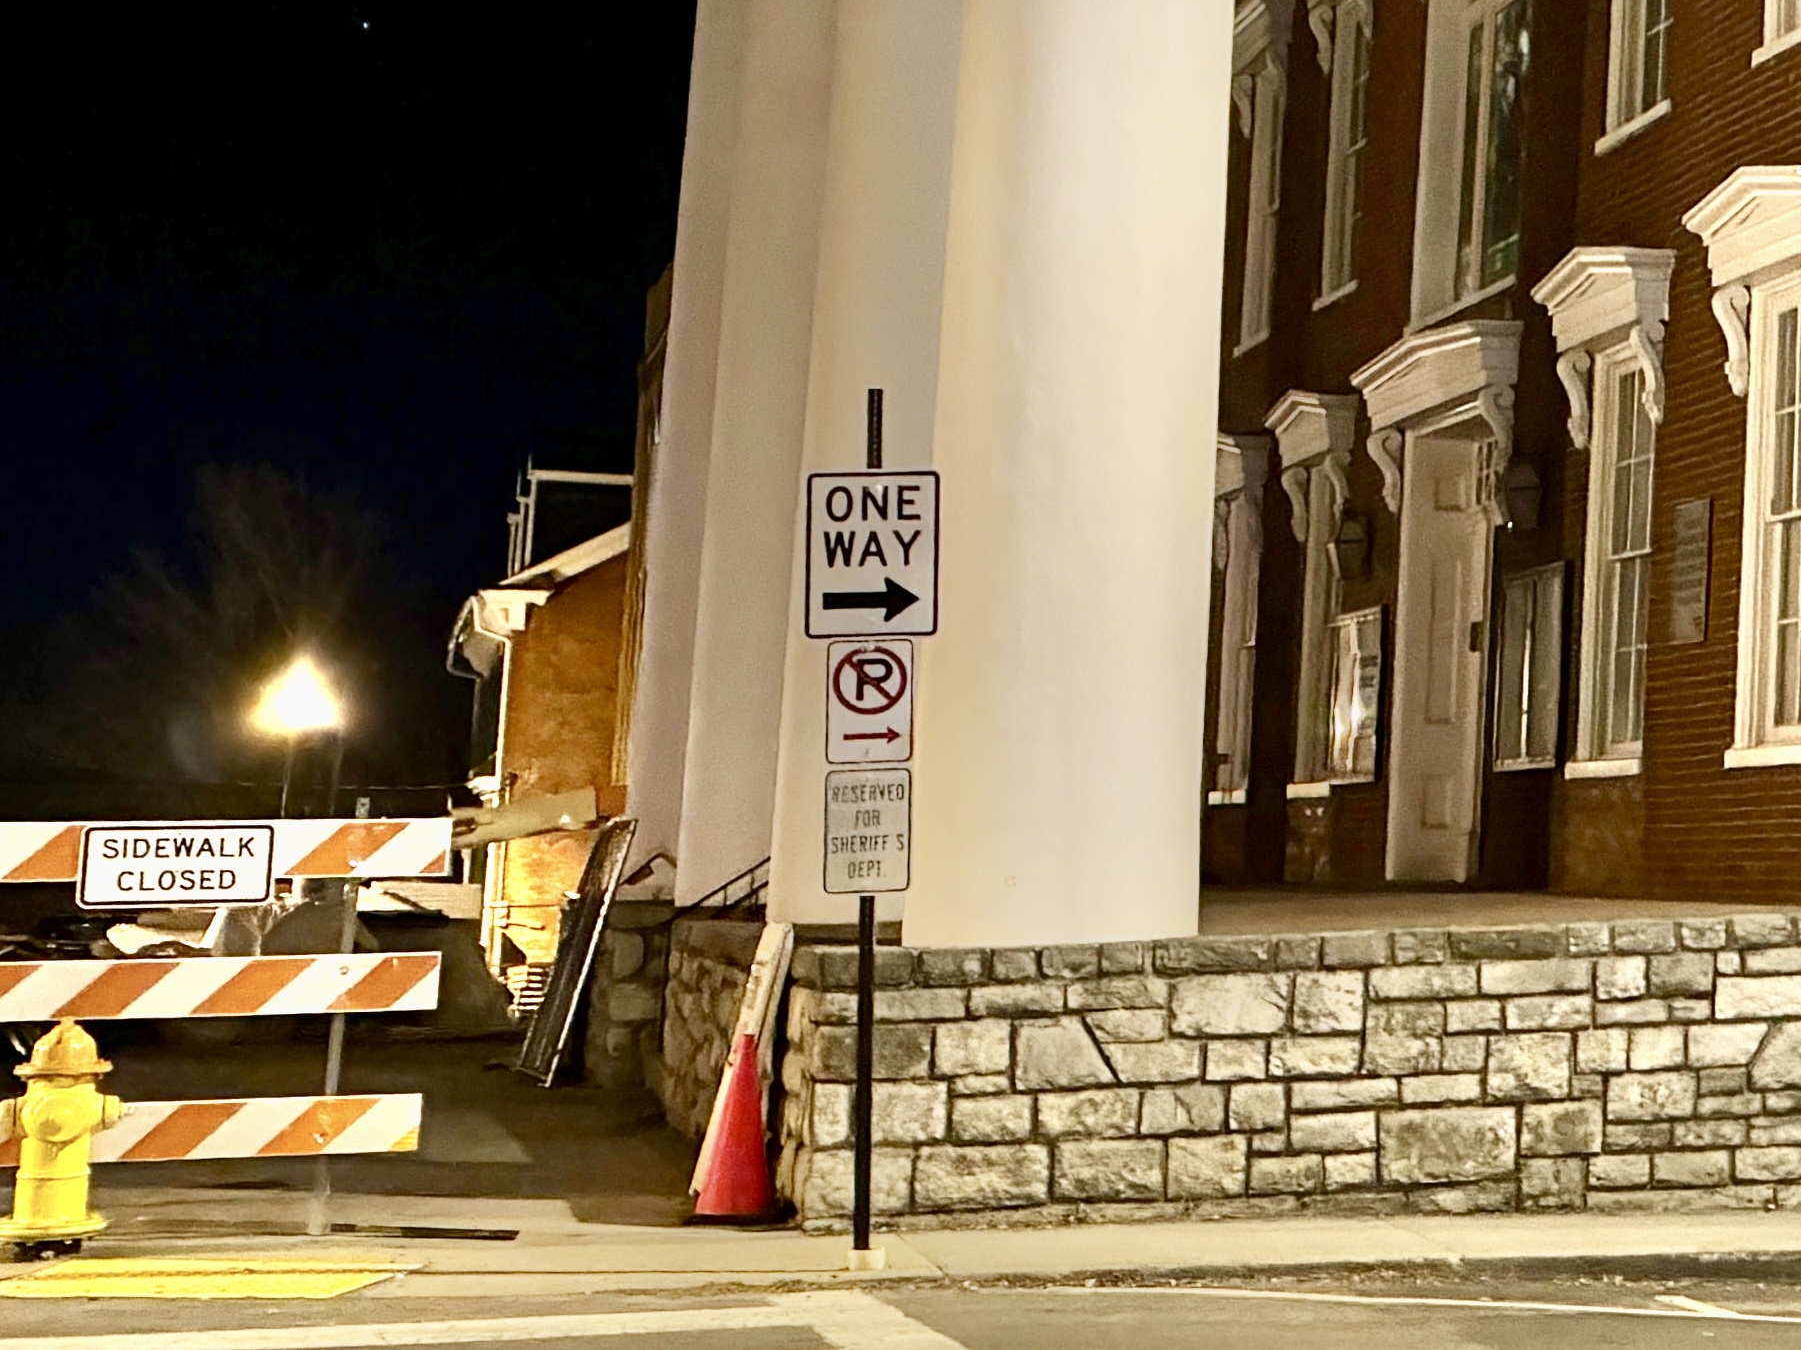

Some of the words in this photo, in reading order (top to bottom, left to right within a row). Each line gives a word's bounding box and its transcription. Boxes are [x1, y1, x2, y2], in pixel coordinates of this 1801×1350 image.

[825, 485, 921, 522] ONE
[823, 530, 921, 568] WAY
[831, 783, 905, 803] RESERVED
[854, 810, 881, 829] FOR
[102, 837, 255, 859] SIDEWALK
[830, 834, 904, 854] SHERIFFS
[117, 869, 236, 891] CLOSED
